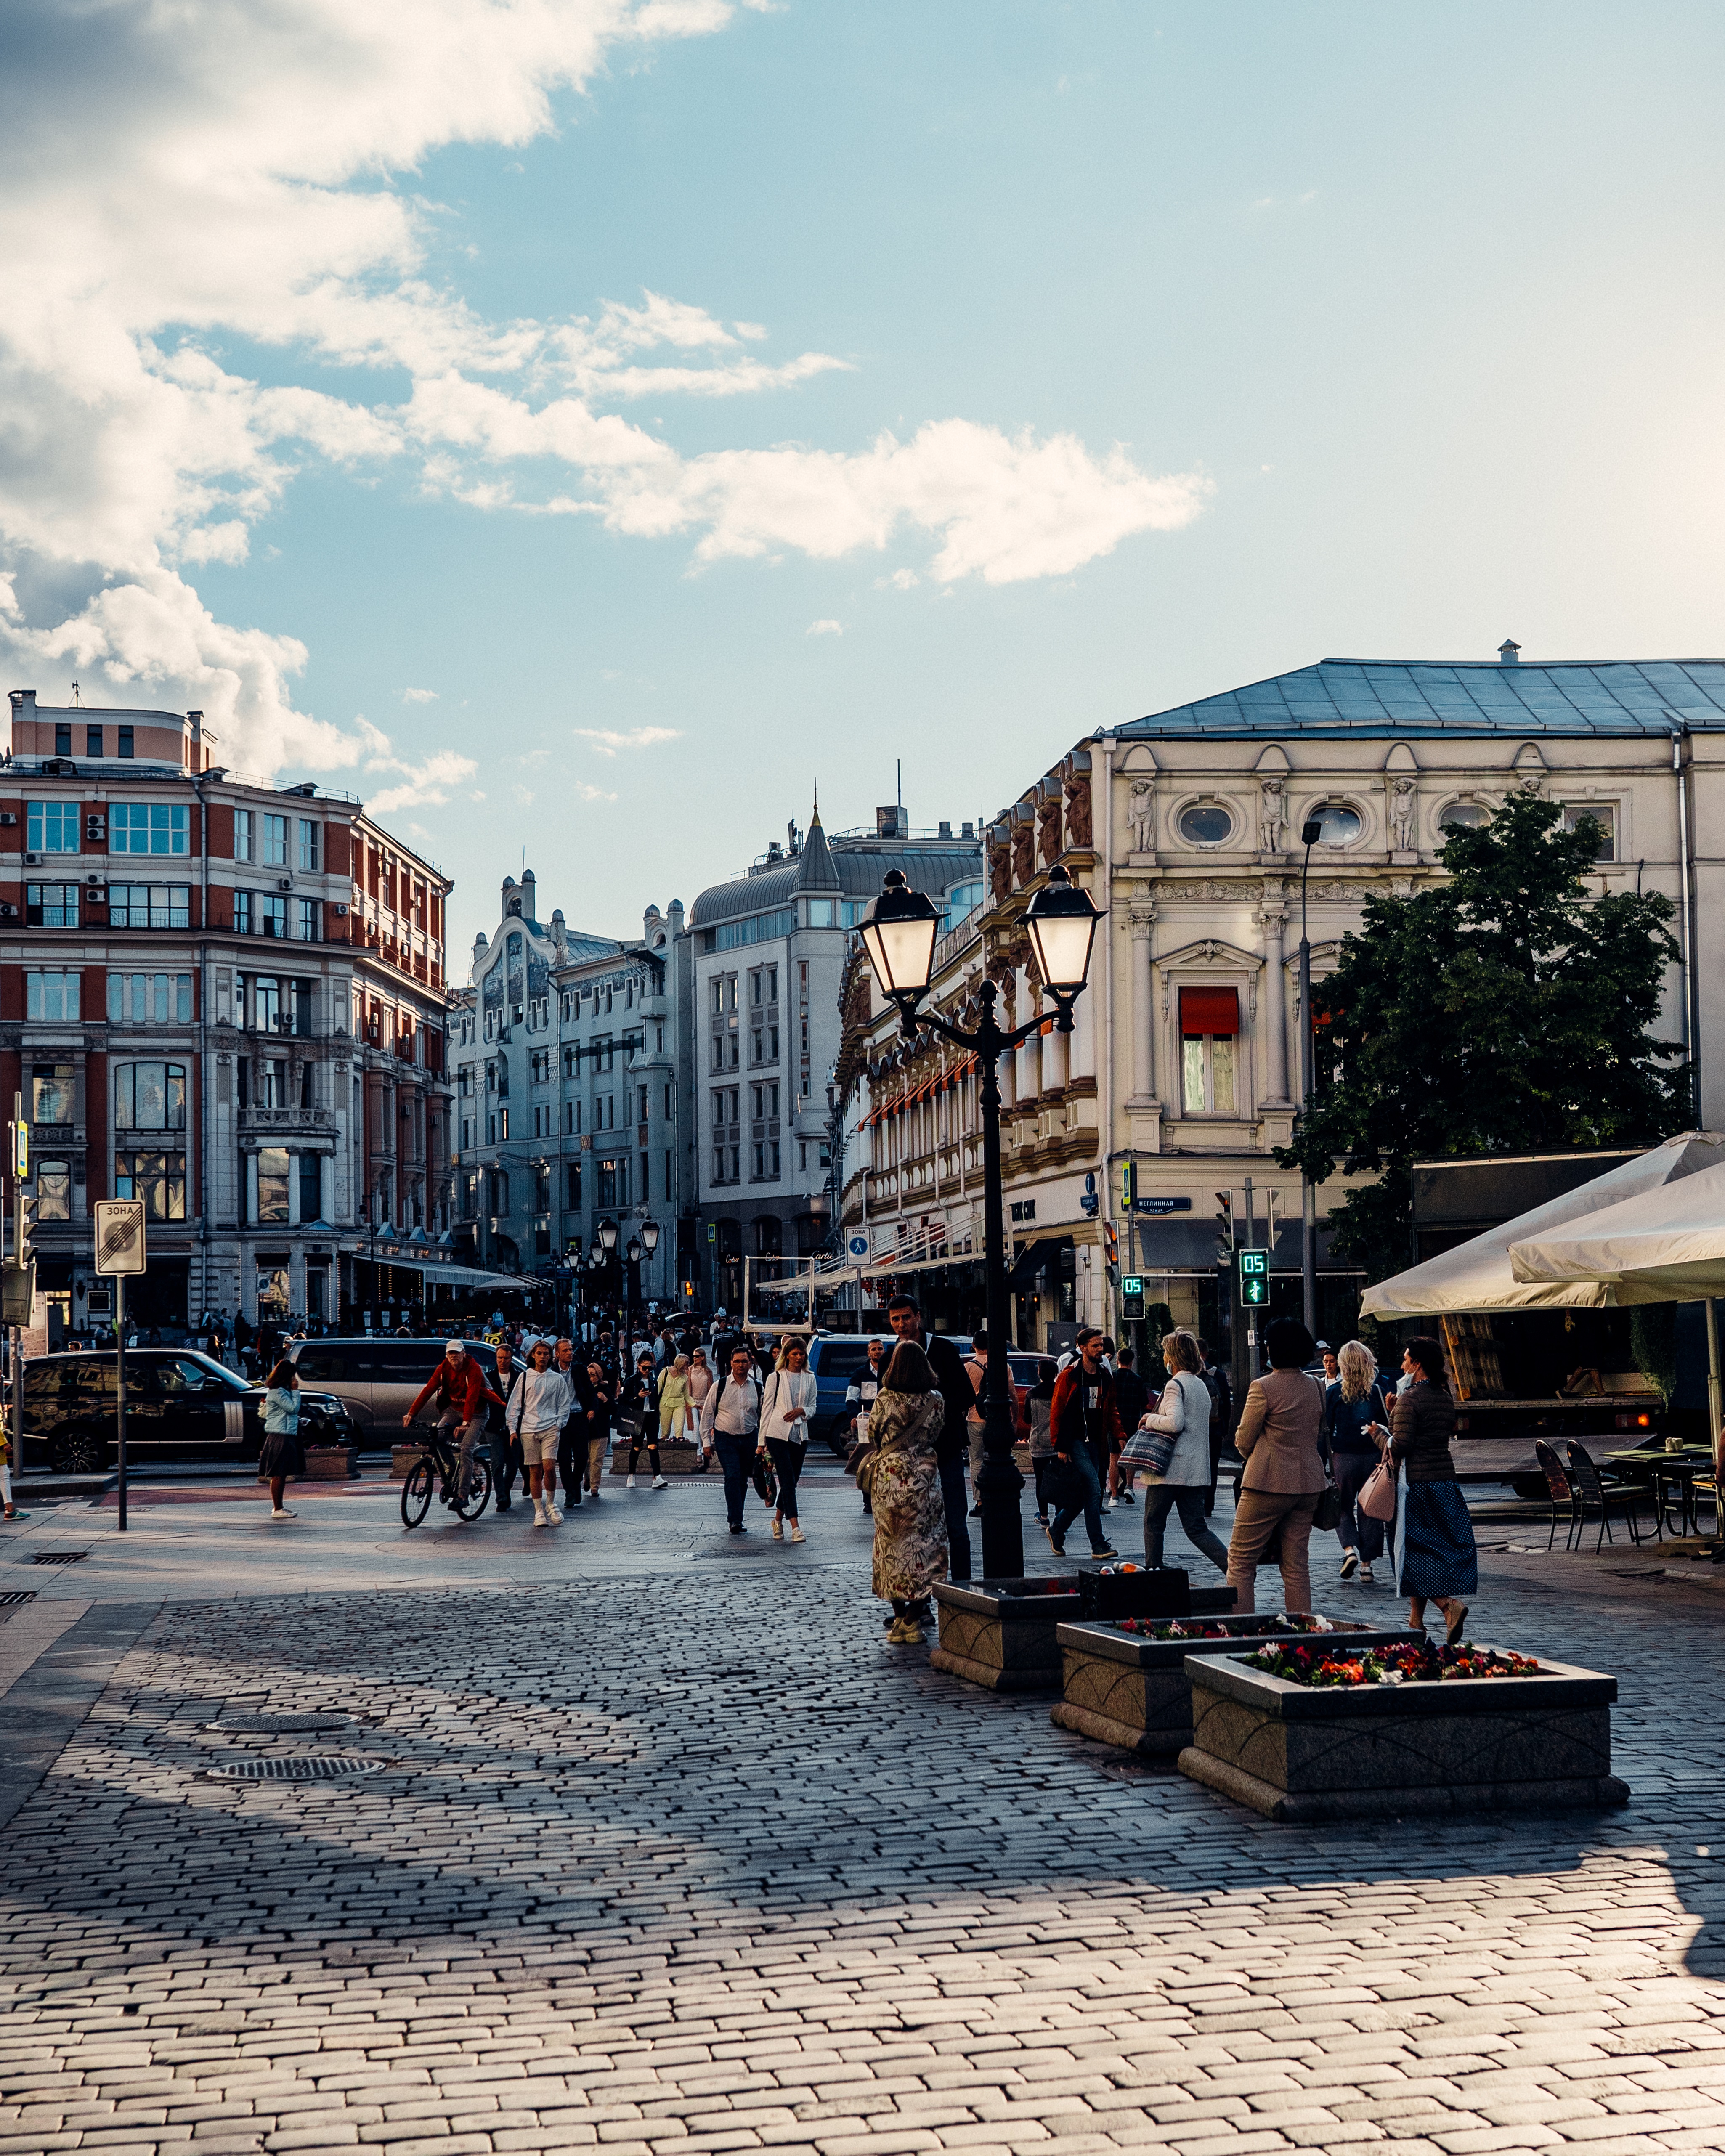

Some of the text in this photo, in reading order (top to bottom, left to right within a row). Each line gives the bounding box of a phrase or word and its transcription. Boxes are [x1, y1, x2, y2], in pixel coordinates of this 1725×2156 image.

[107, 1207, 134, 1215] ЗОНА
[726, 1254, 740, 1263] Cartier
[811, 1250, 833, 1260] Cartie
[1244, 1256, 1263, 1272] 05
[1125, 1279, 1141, 1292] 05
